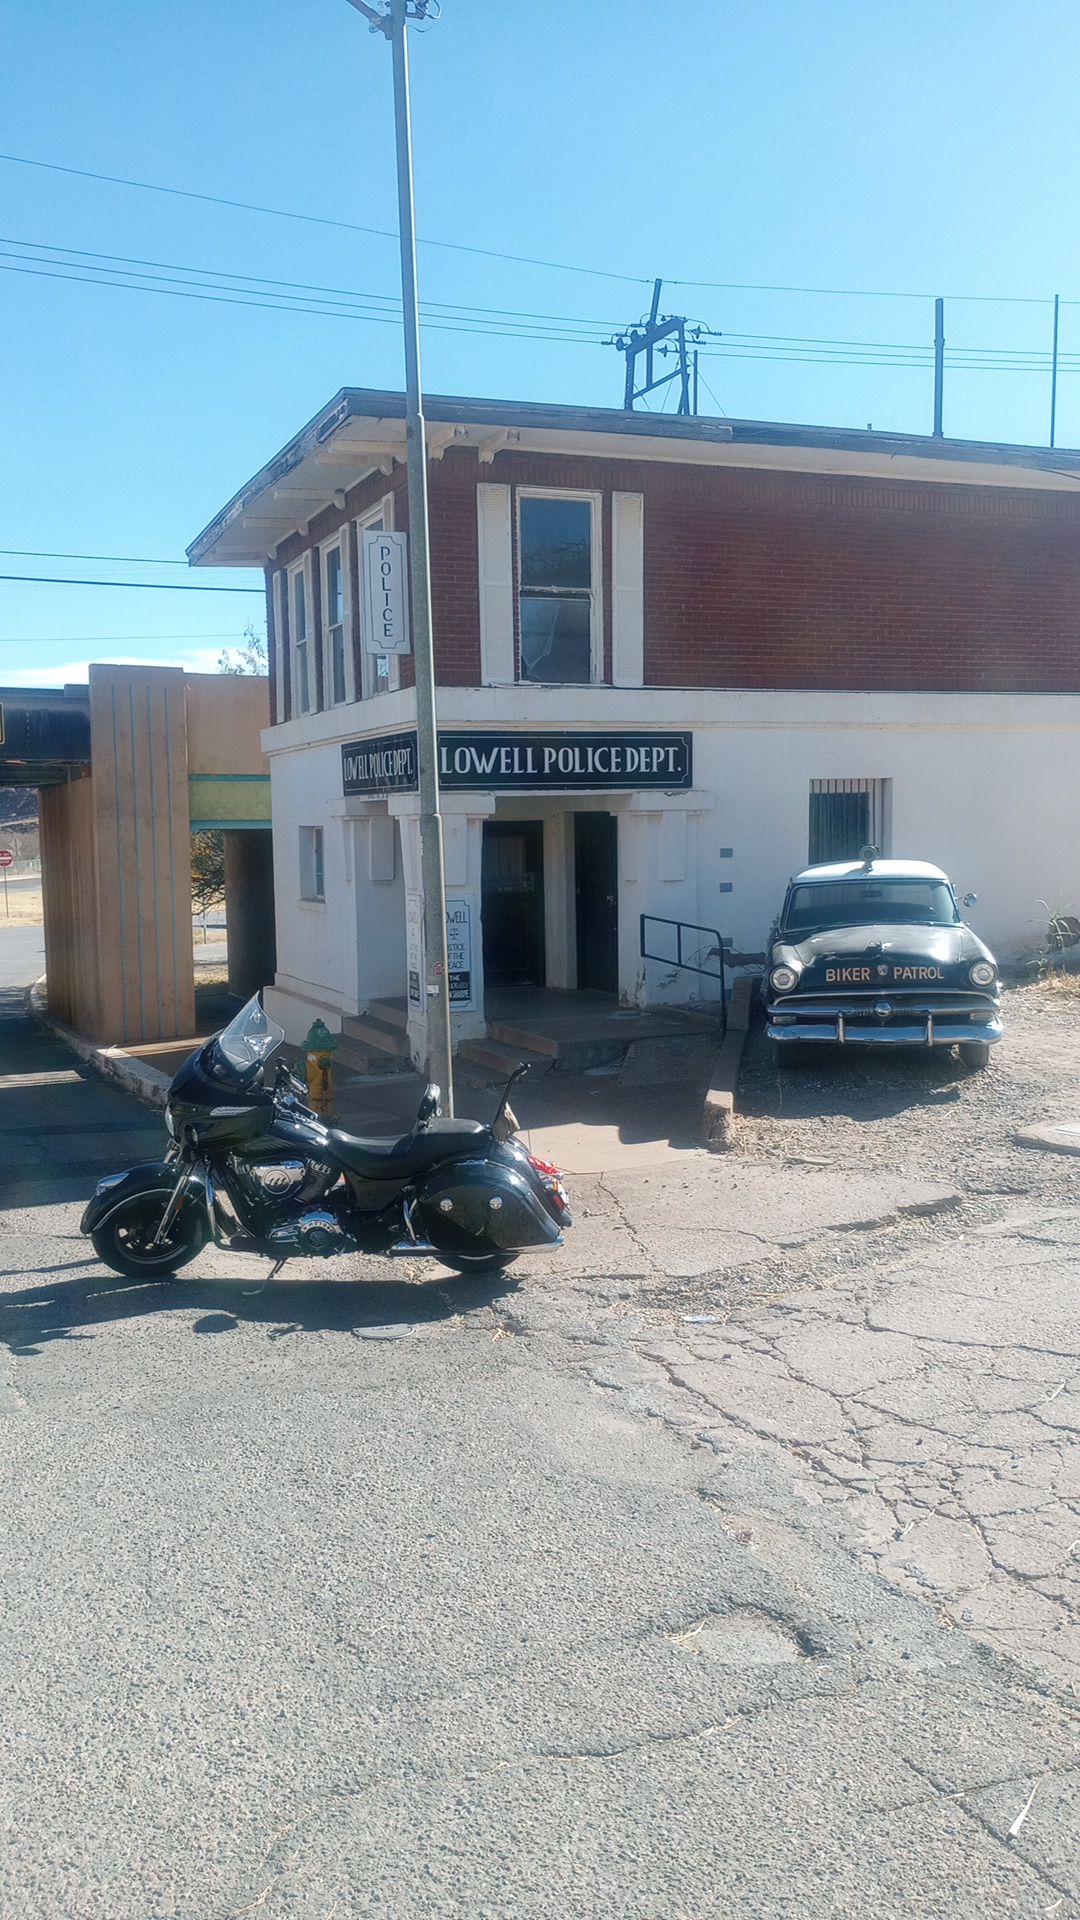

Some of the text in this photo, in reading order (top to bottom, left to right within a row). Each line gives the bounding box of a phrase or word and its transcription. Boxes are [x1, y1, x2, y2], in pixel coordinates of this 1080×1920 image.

[381, 546, 394, 637] POLICE
[344, 747, 413, 781] LOWELL POLICE DEPT.
[440, 746, 682, 774] LOWELL POLICE DEPT.
[446, 911, 468, 924] WELL
[447, 961, 464, 969] EACE
[826, 966, 944, 982] BIKER PATROL
